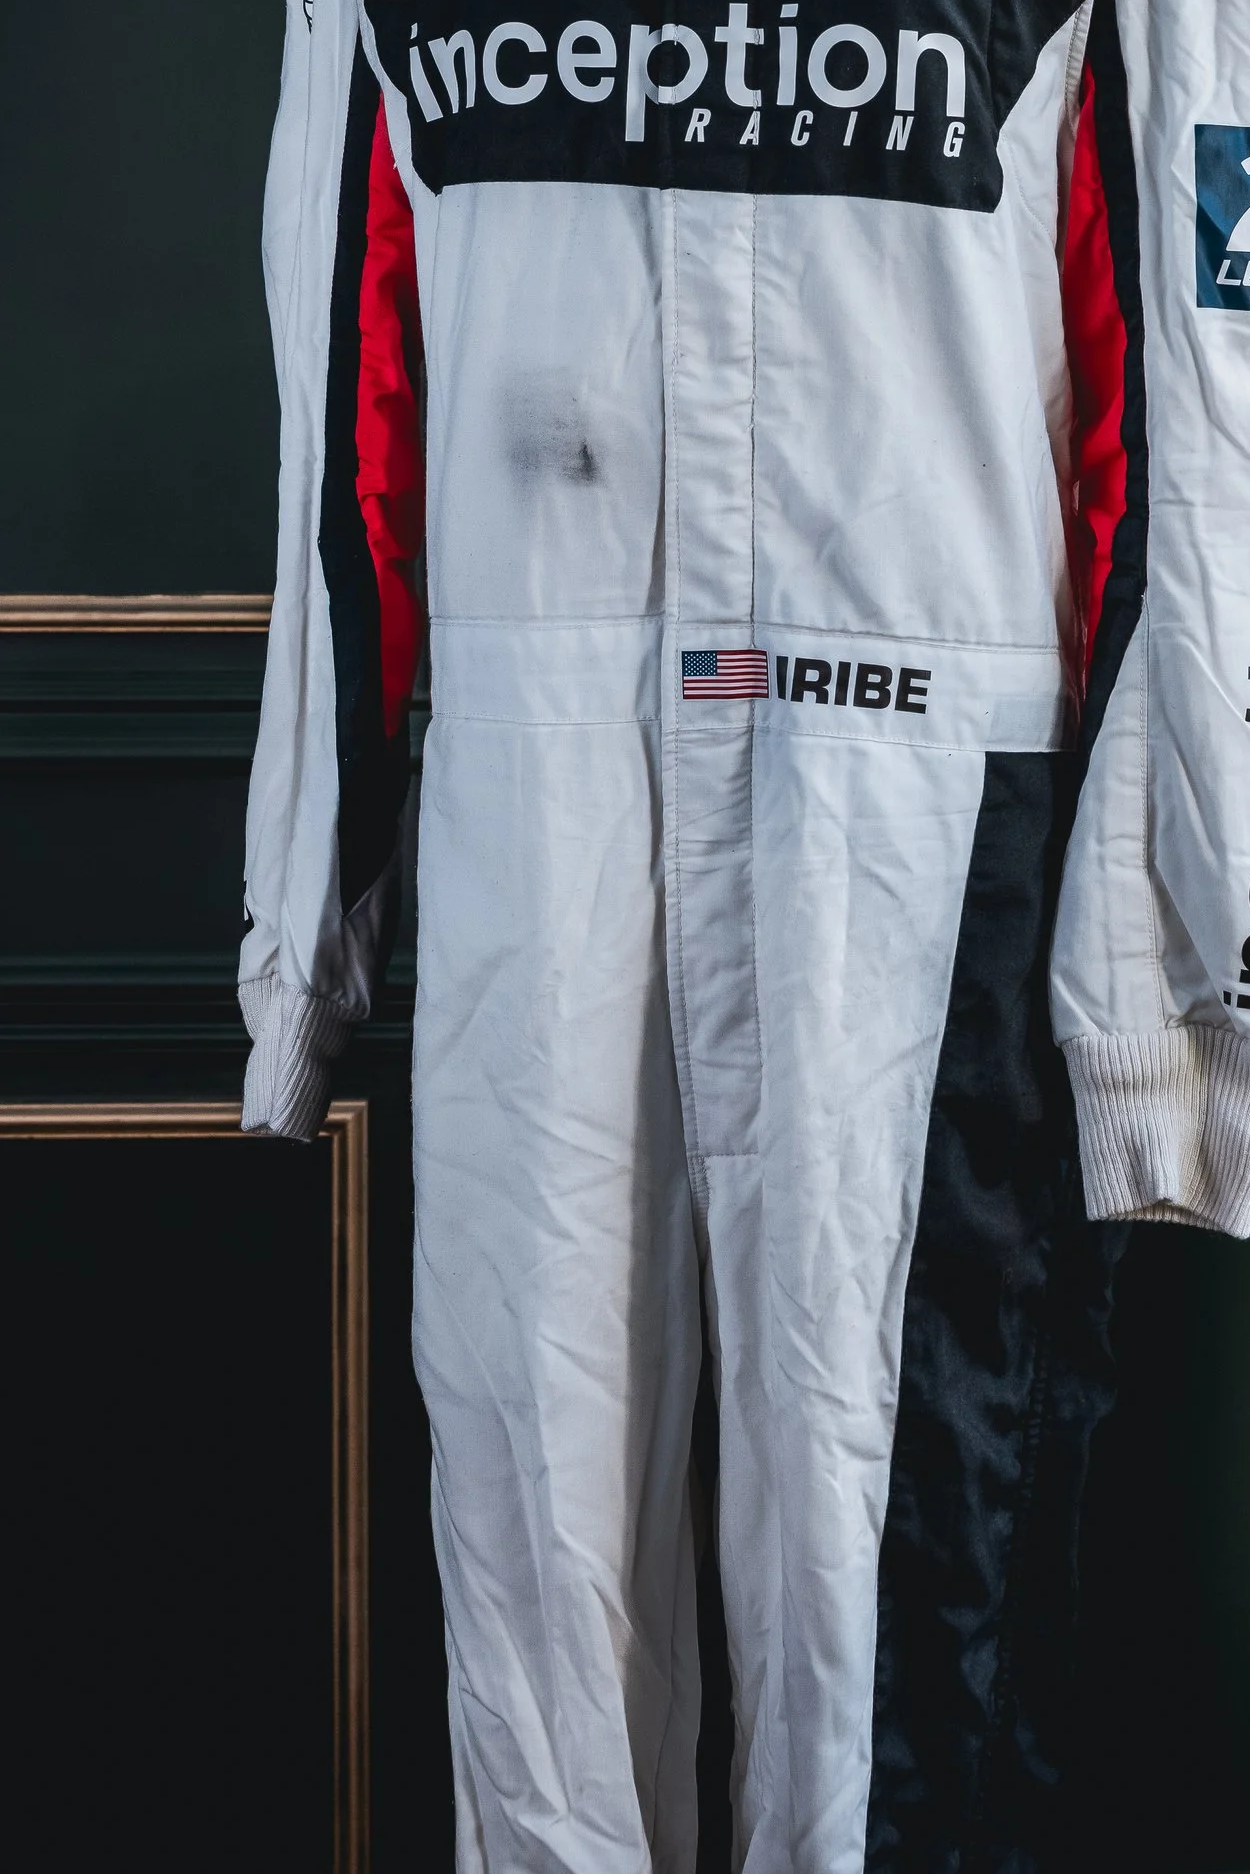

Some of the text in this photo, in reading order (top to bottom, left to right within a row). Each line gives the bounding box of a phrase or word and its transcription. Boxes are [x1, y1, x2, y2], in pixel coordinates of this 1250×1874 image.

[410, 3, 965, 141] inception
[685, 108, 965, 157] RACING
[776, 655, 931, 714] IRIBE
